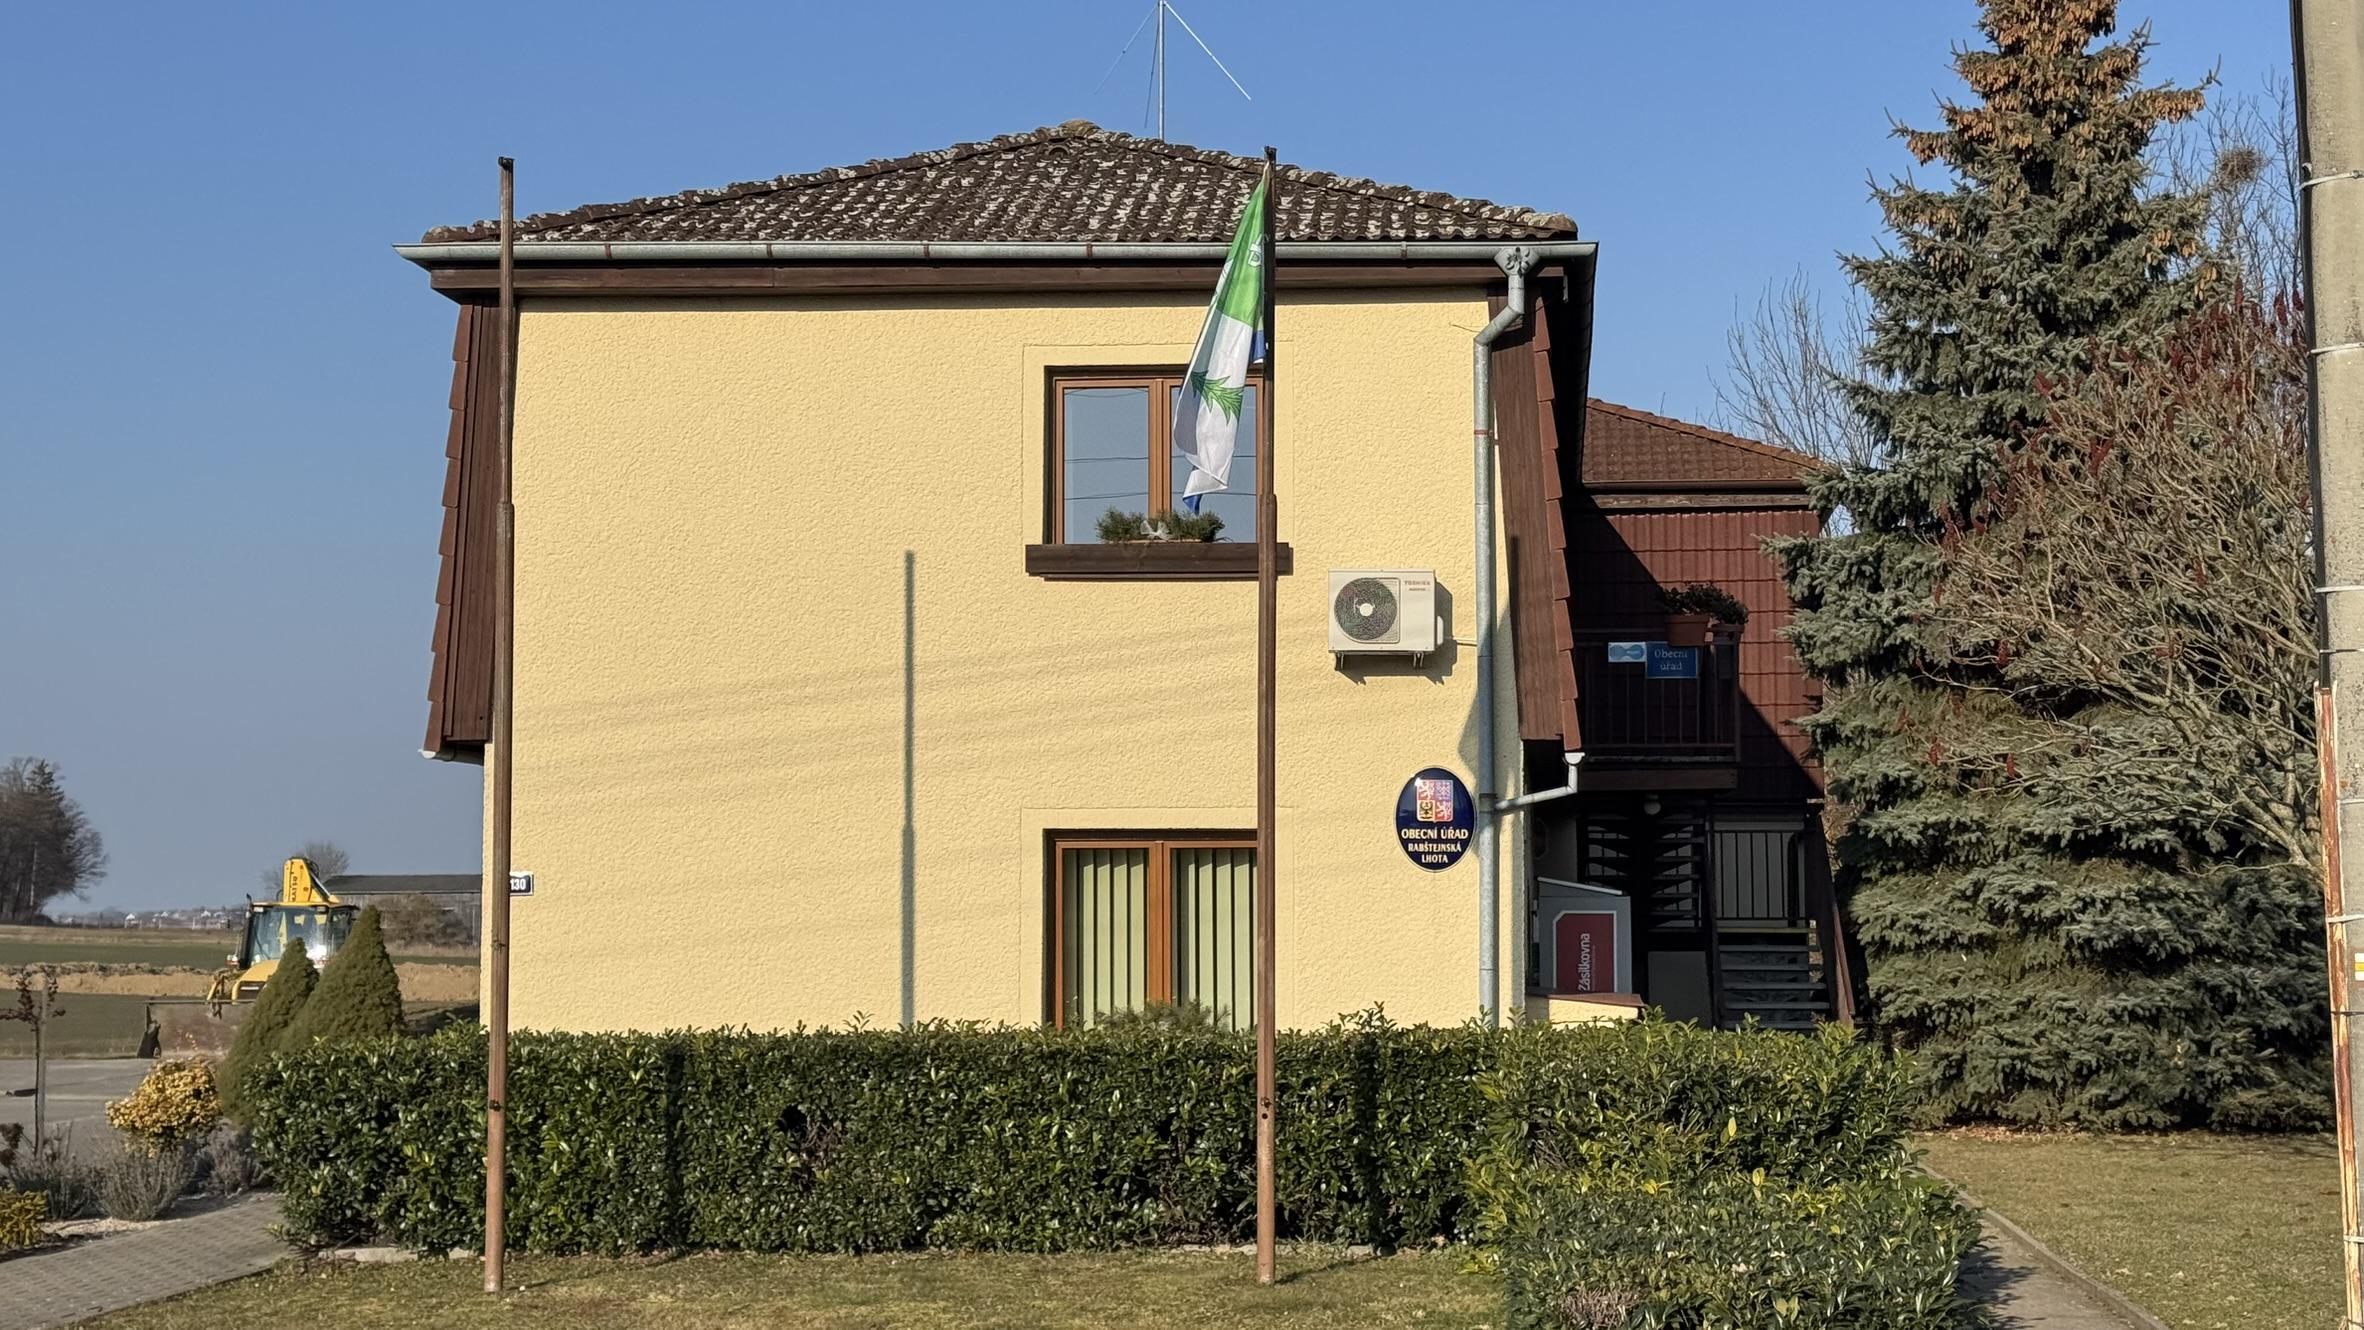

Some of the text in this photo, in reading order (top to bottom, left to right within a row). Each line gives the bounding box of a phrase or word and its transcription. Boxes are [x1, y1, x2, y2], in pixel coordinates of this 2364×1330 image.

[1401, 826, 1469, 839] OBECNÍ ÚŘAD
[1408, 841, 1462, 852] RABŠTEJNSKÁ
[1421, 854, 1449, 863] LHOTA
[510, 878, 526, 890] 130
[1578, 933, 1591, 991] Zásilkovna
